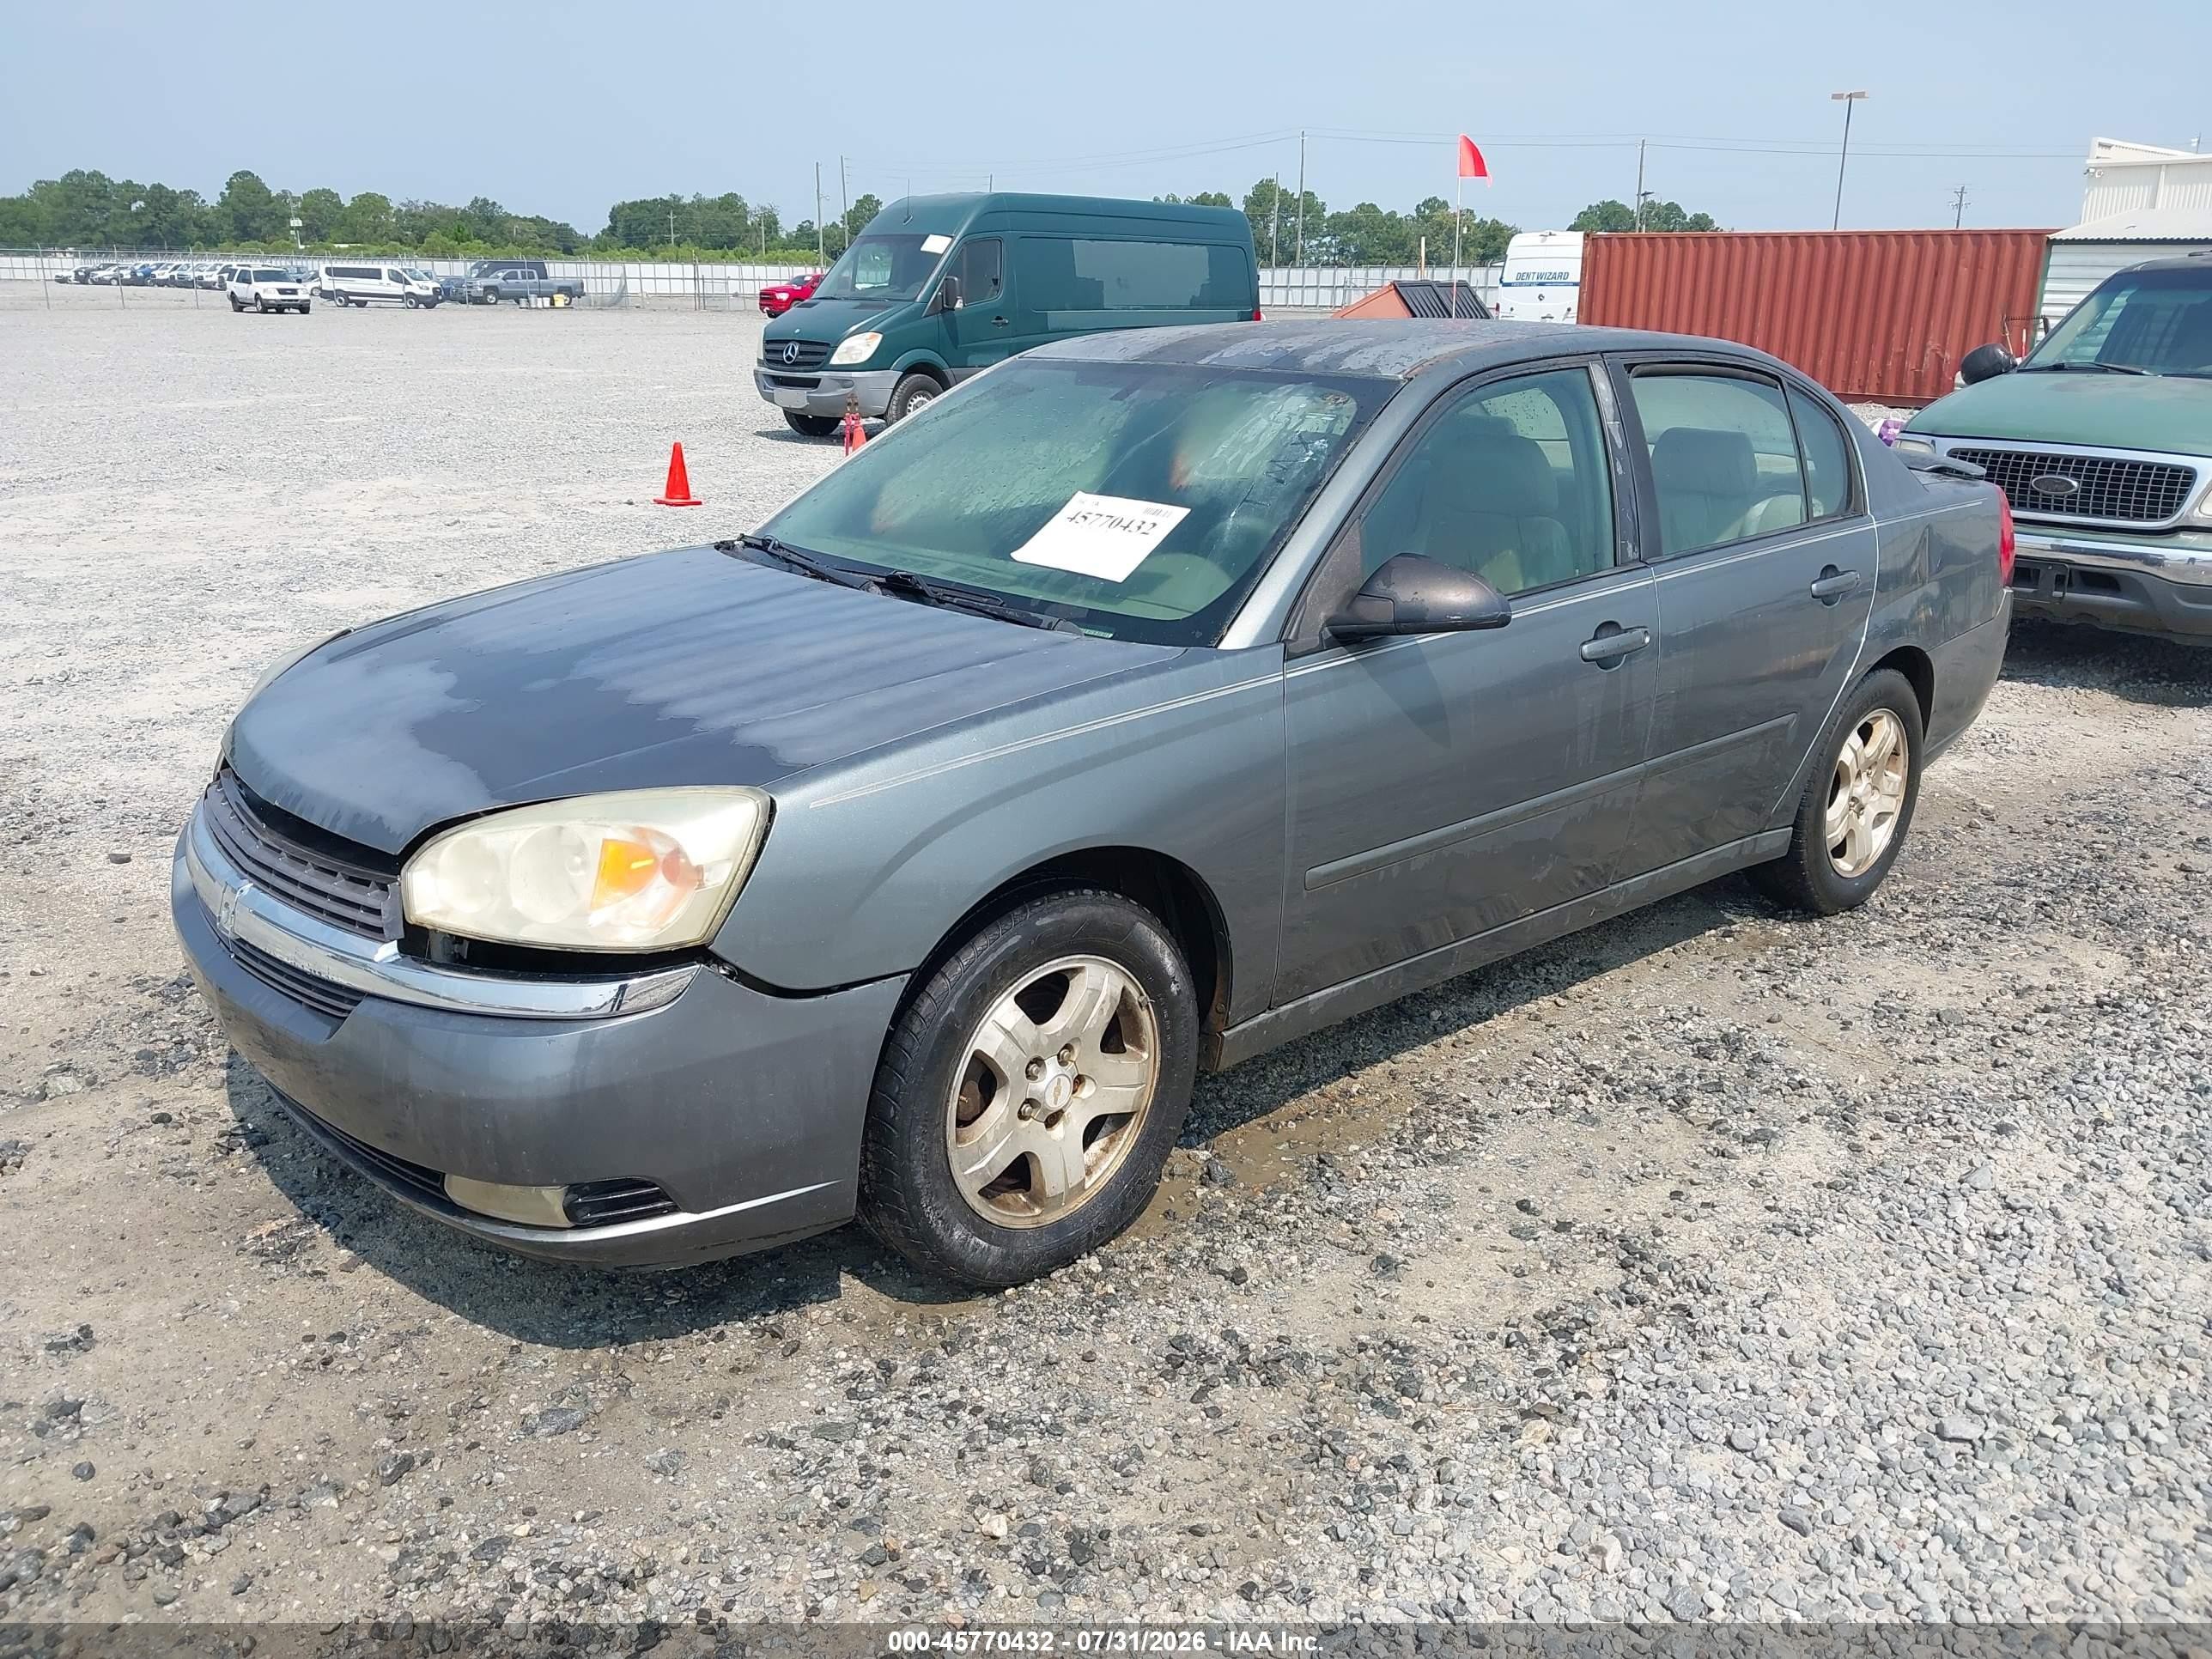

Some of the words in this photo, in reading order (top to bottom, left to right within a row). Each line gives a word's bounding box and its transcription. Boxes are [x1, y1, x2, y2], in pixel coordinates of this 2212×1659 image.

[1516, 271, 1535, 281] DENT
[1536, 271, 1570, 281] WIZARD
[1066, 511, 1158, 535] 45770432
